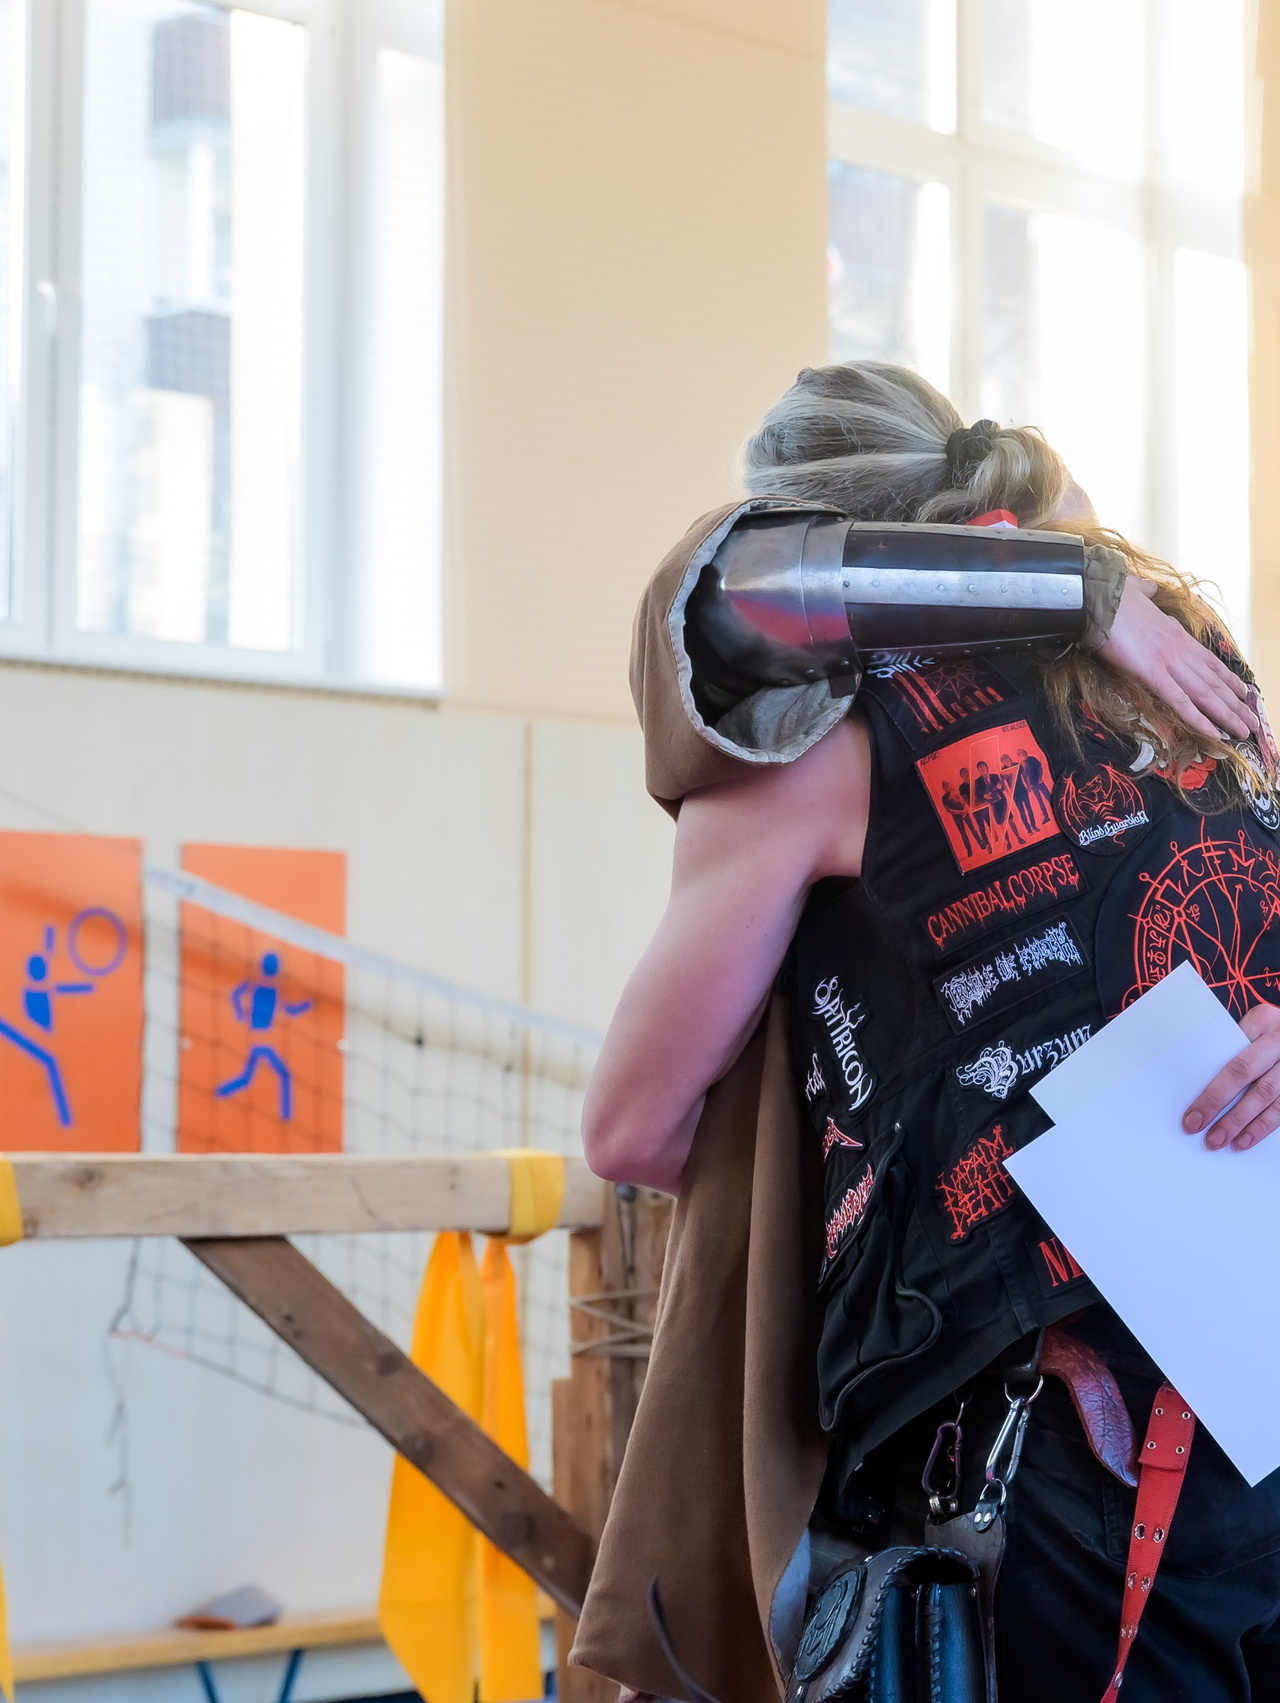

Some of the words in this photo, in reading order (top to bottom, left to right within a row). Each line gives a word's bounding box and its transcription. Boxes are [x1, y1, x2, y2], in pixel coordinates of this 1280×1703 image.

[1078, 825, 1105, 846] Blind
[1103, 810, 1149, 836] Guardian
[996, 951, 1021, 984] OF
[811, 975, 873, 1112] SATYRICON
